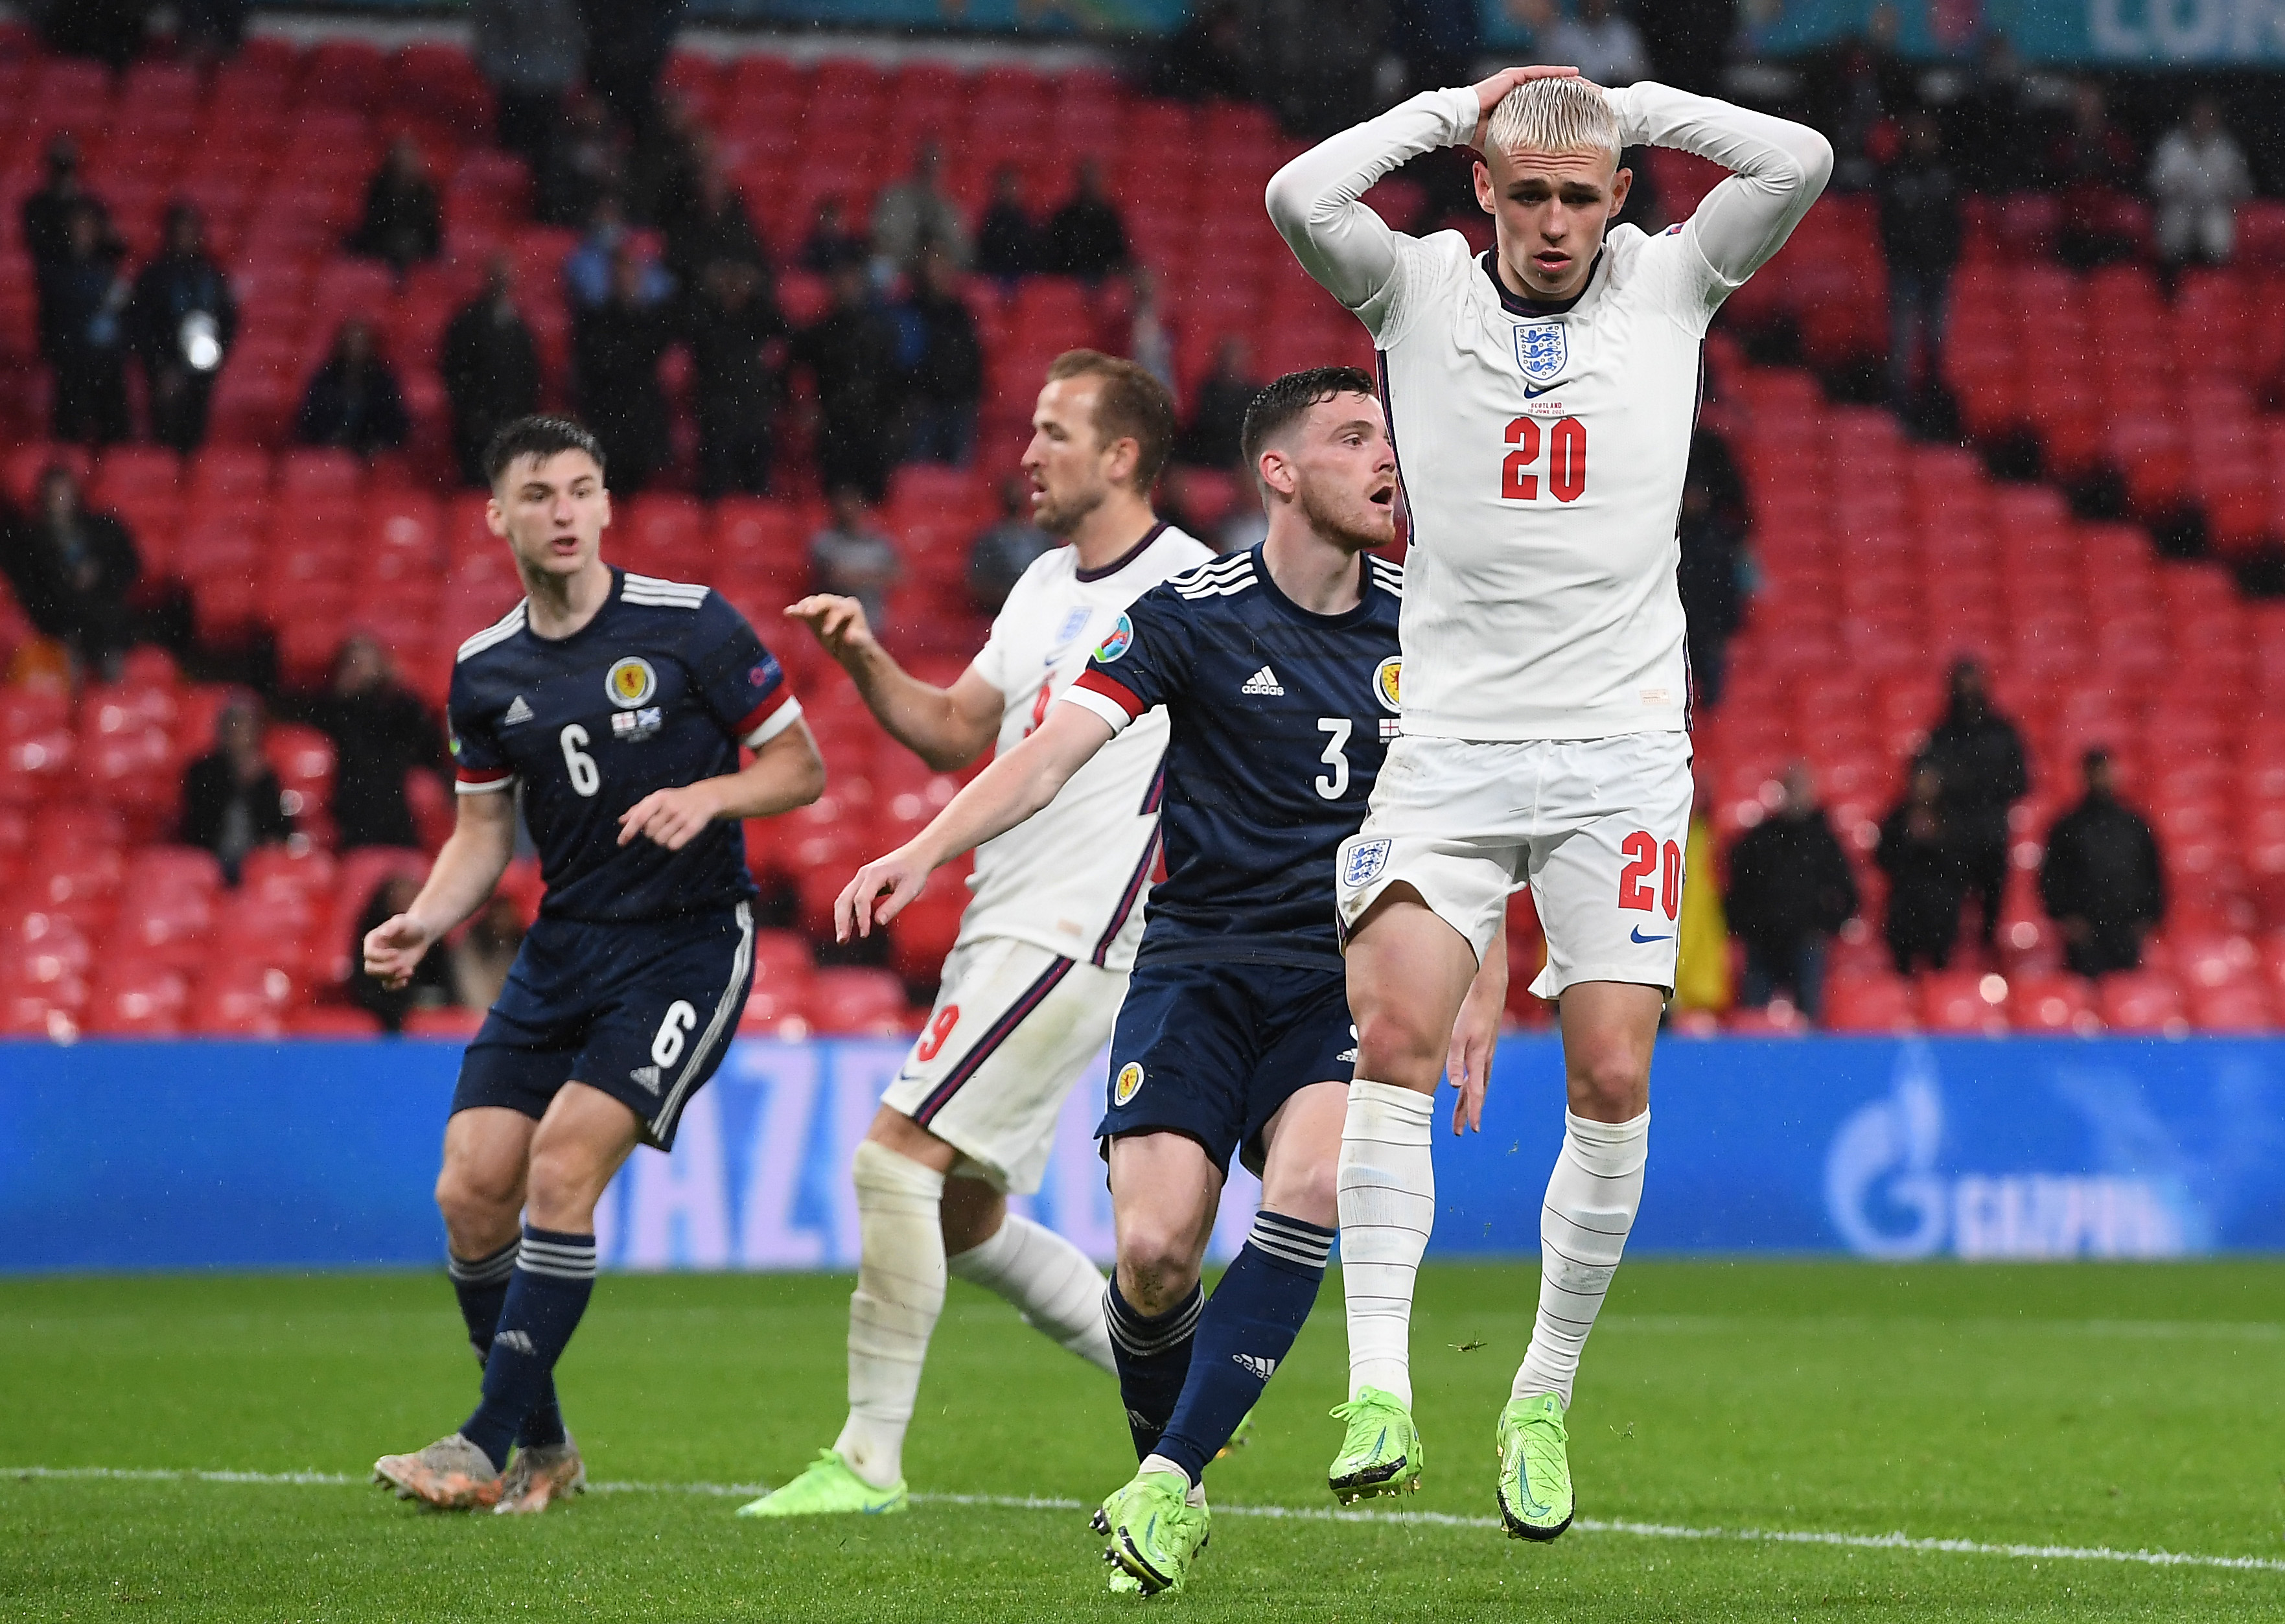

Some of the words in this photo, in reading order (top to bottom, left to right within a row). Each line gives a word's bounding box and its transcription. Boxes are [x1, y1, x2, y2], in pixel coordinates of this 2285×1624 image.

[1501, 416, 1586, 502] 20
[1241, 682, 1285, 697] adidas
[560, 723, 600, 797] 6
[1315, 717, 1352, 800] 3
[1618, 830, 1682, 922] 20
[651, 999, 697, 1069] 6
[918, 1004, 960, 1061] 9
